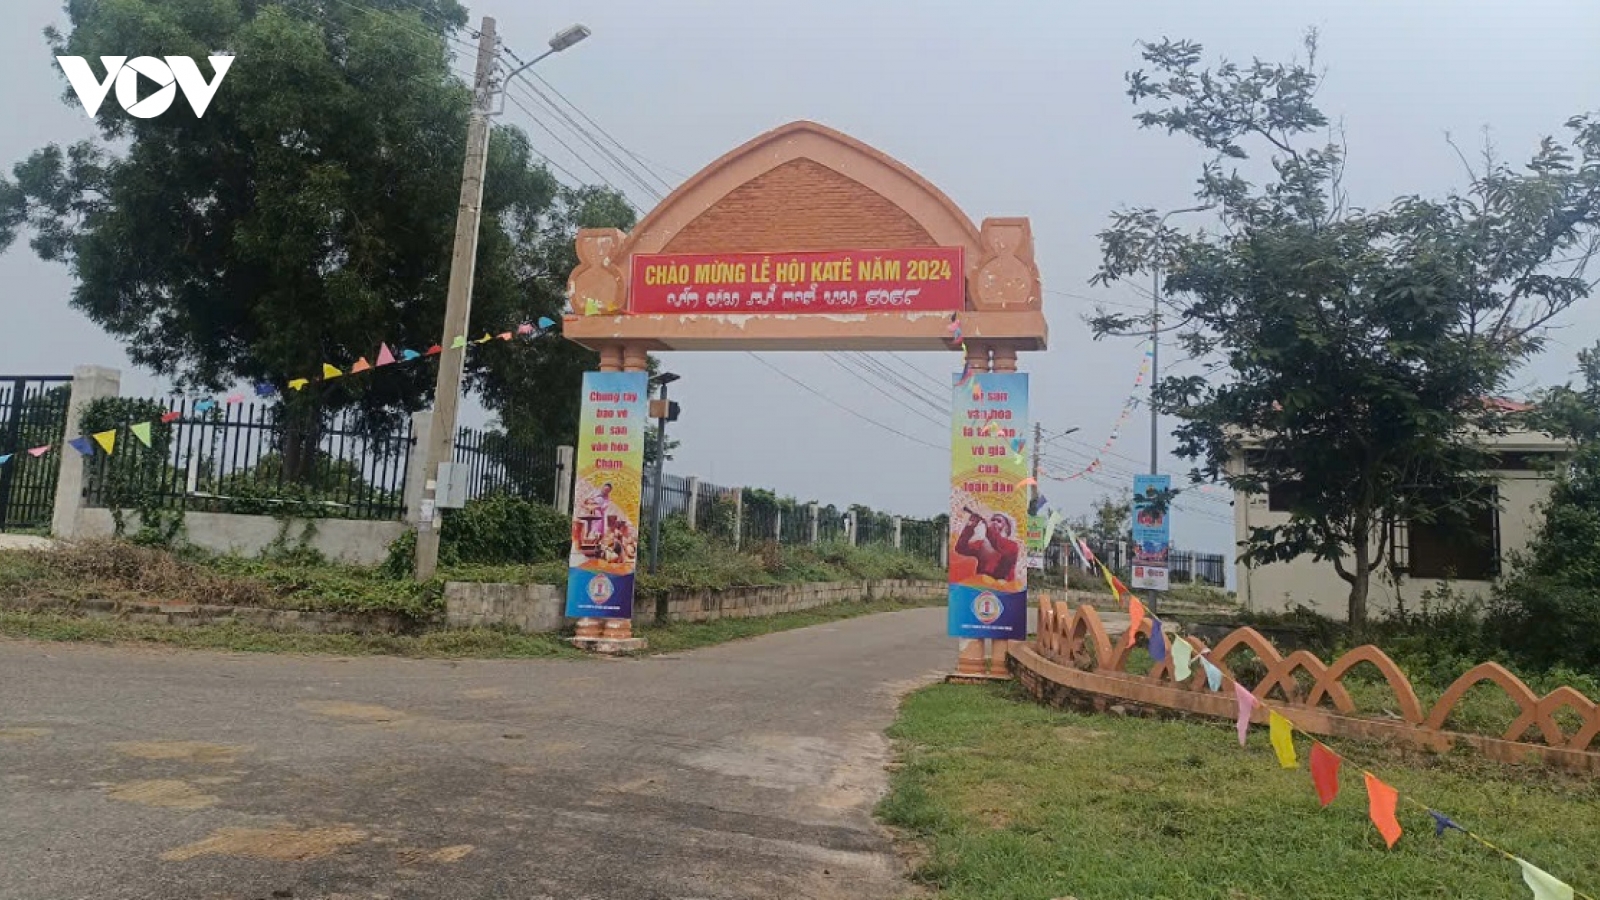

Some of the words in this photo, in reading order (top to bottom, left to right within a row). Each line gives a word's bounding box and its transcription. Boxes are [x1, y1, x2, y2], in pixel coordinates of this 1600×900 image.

[645, 261, 690, 285] CHÀO
[695, 260, 746, 284] MỪNG
[751, 255, 770, 283] LỄ
[776, 258, 805, 287] HỘI
[810, 256, 852, 282] KATÊ
[858, 256, 901, 282] NĂM
[906, 259, 952, 280] 2024
